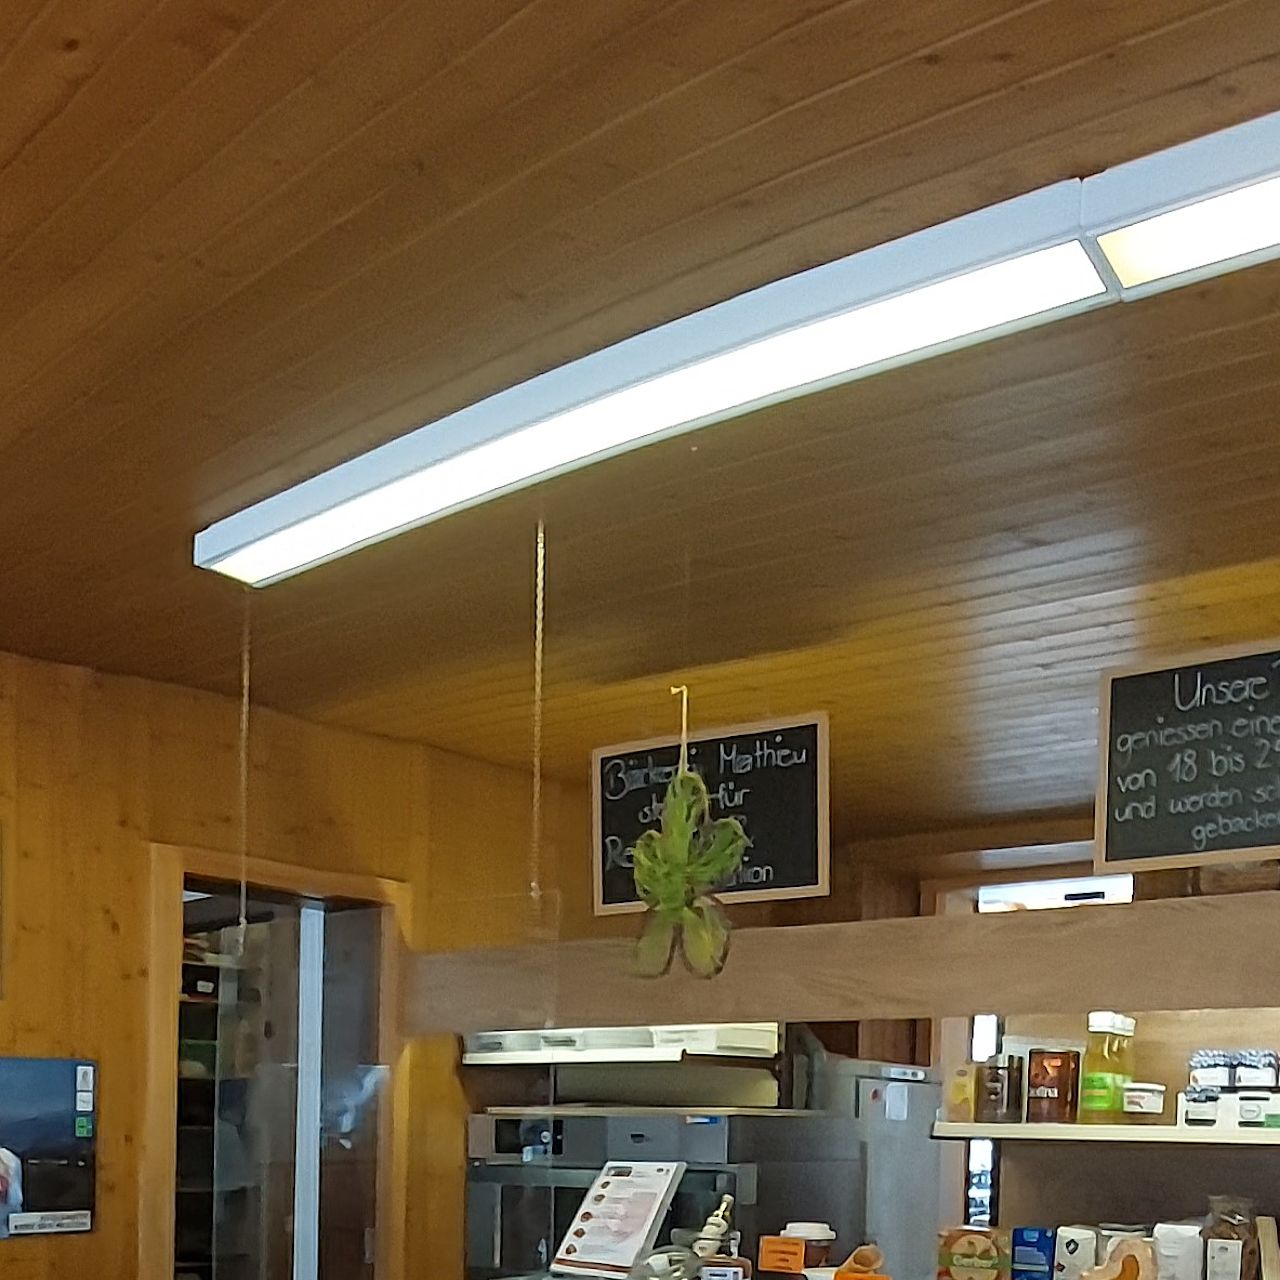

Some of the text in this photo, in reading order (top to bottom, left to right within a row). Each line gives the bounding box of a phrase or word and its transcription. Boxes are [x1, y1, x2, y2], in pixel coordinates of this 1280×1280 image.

[1173, 670, 1270, 712] Unsere
[719, 734, 807, 774] Mathieu
[1116, 714, 1223, 758] geniessen
[1116, 768, 1157, 793] von
[1168, 749, 1198, 783] 18
[1209, 745, 1245, 777] bis
[717, 780, 751, 811] für
[1114, 794, 1157, 822] und
[1169, 784, 1243, 815] werden
